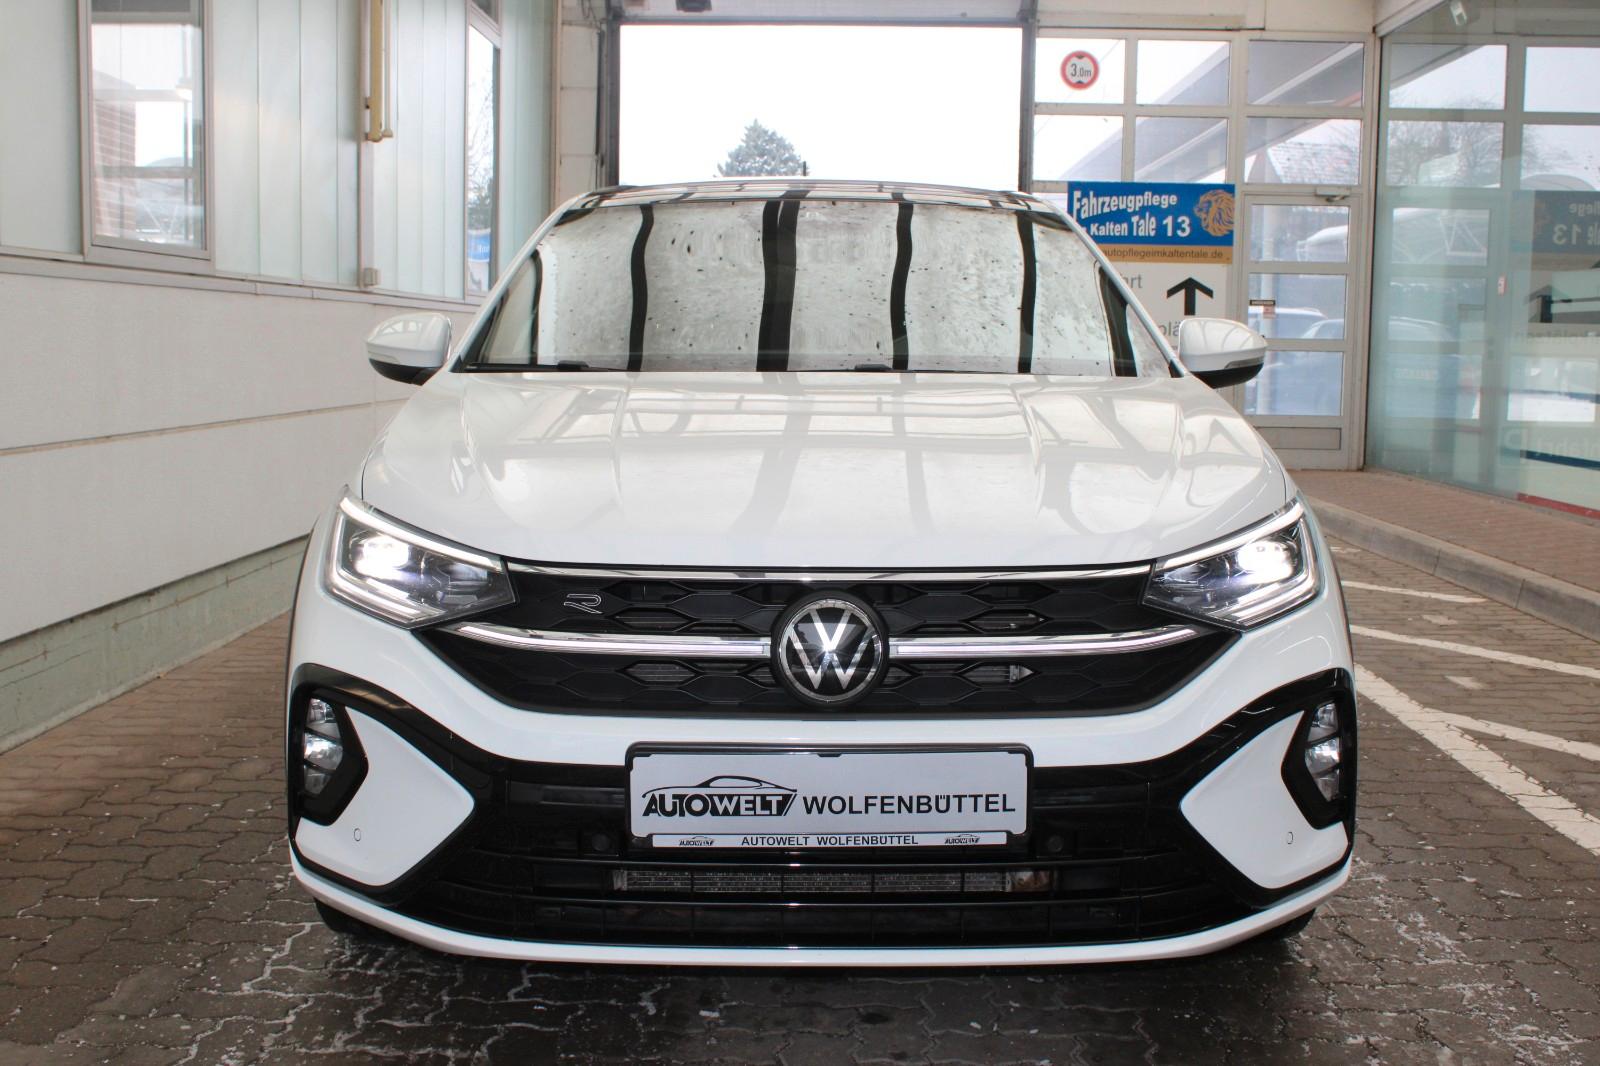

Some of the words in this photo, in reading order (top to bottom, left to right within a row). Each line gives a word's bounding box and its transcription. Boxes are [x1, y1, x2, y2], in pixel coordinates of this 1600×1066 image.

[1073, 190, 1178, 221] Fahrzeugpflege
[1090, 221, 1128, 236] Kalten
[1131, 211, 1157, 237] Tale
[1162, 215, 1191, 237] 13
[642, 793, 797, 817] AUTOWELT
[803, 793, 1016, 815] WOLFENBÜTTEL
[741, 836, 810, 846] AUTOWELT
